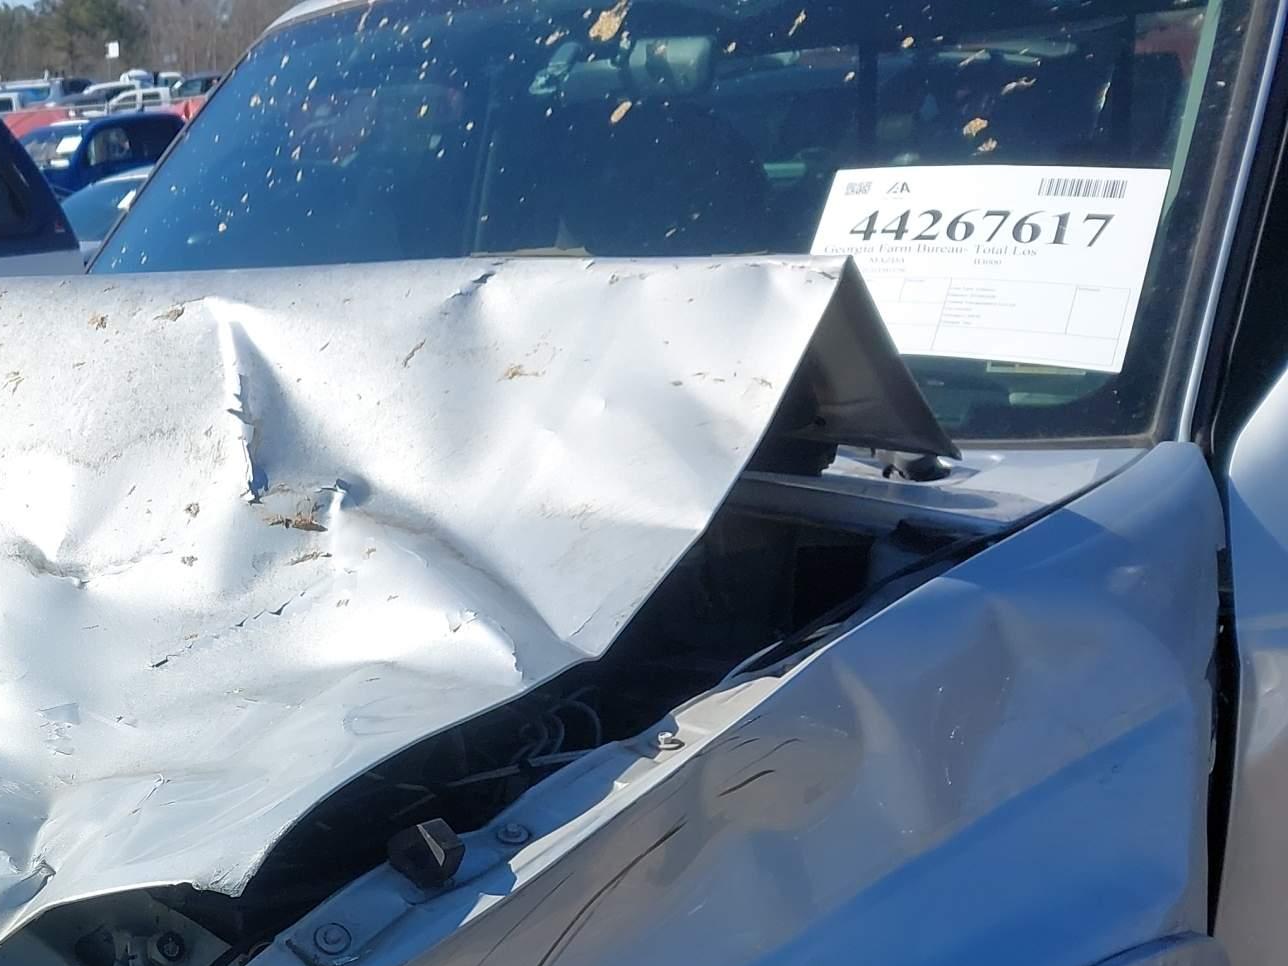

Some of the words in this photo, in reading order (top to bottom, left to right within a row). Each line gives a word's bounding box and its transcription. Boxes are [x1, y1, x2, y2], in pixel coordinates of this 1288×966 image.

[849, 208, 1116, 247] 44267617
[824, 244, 874, 256] Georgia
[878, 243, 912, 254] Farm
[975, 244, 1008, 256] Total
[1012, 246, 1039, 257] Los
